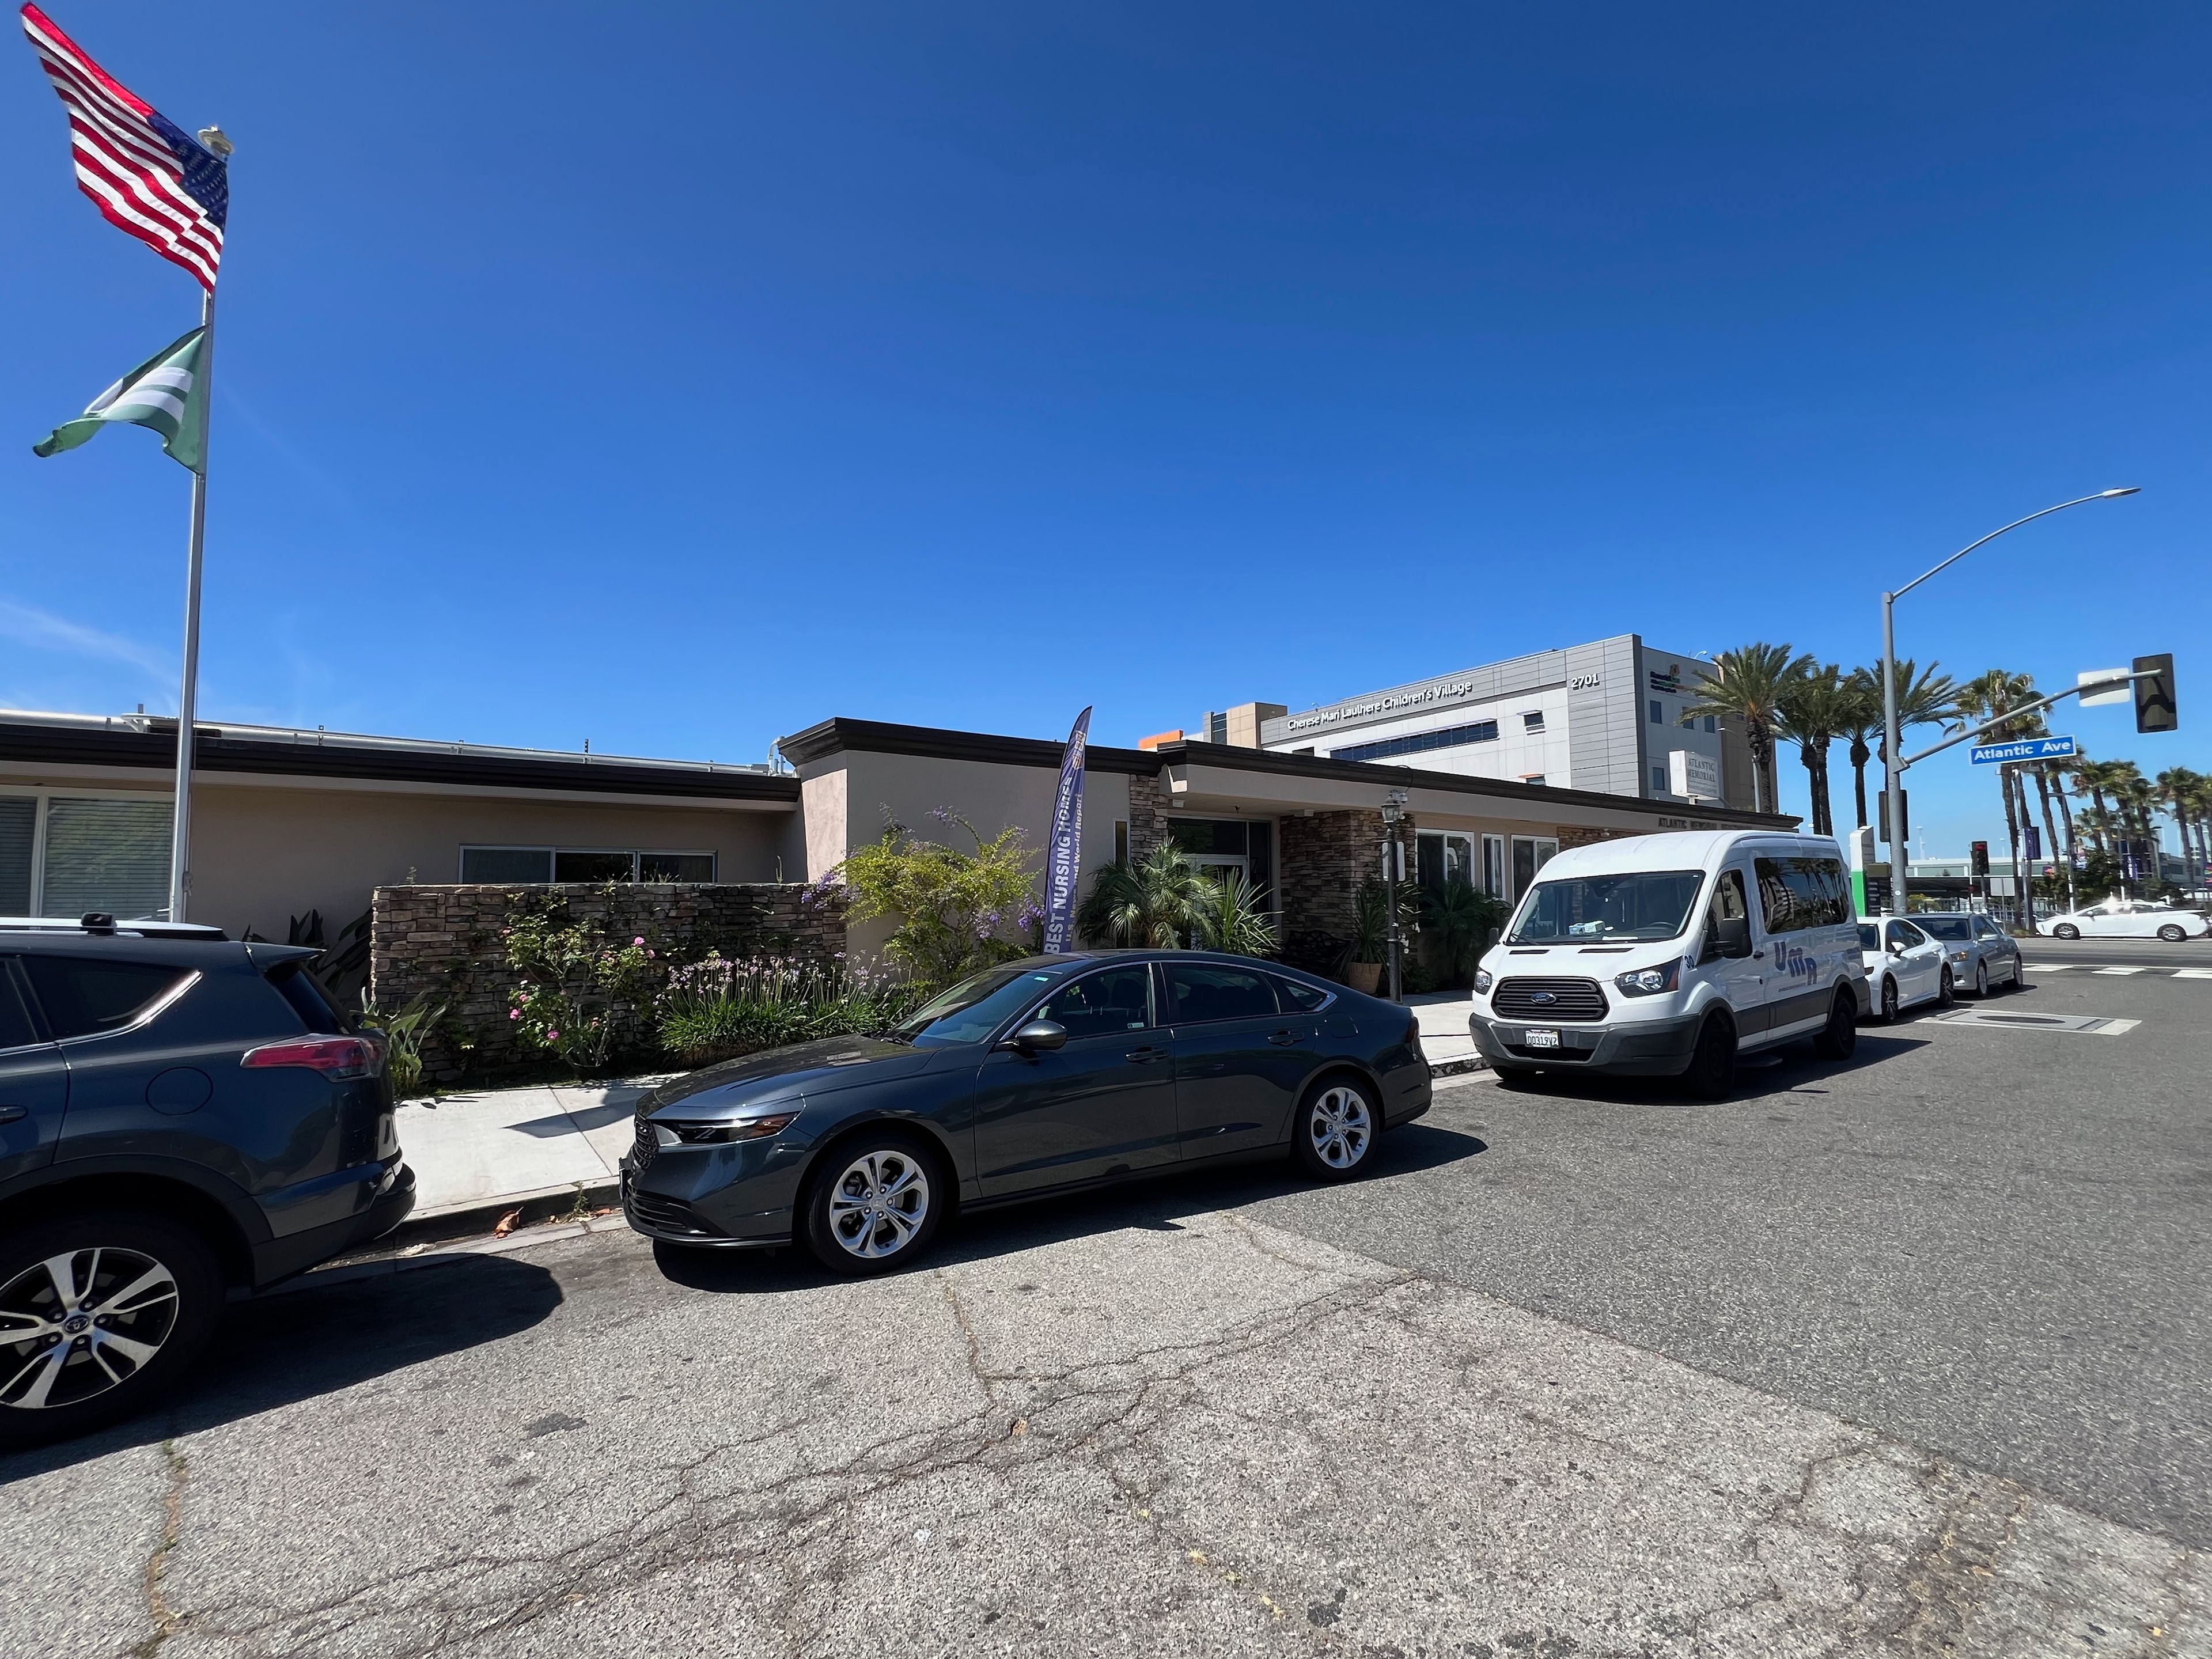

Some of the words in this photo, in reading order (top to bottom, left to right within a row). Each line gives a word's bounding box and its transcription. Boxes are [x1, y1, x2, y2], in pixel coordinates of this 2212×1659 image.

[1571, 673, 1600, 688] 2701
[1287, 715, 1320, 730] Cherese
[1321, 709, 1340, 723] Mari
[1342, 701, 1380, 718] Laulhere
[1382, 689, 1432, 709] Children's
[1433, 681, 1472, 698] Village
[1974, 744, 2034, 761] Atlantic
[2041, 741, 2071, 753] Ave
[1688, 758, 1715, 772] ATLANTIC
[1687, 768, 1716, 782] MEMORIAL
[1074, 793, 1083, 830] Report
[1658, 817, 1687, 830] ATLANTIC
[1052, 836, 1071, 910] NURSING
[1044, 912, 1065, 955] BEST
[1684, 955, 1695, 969] 30
